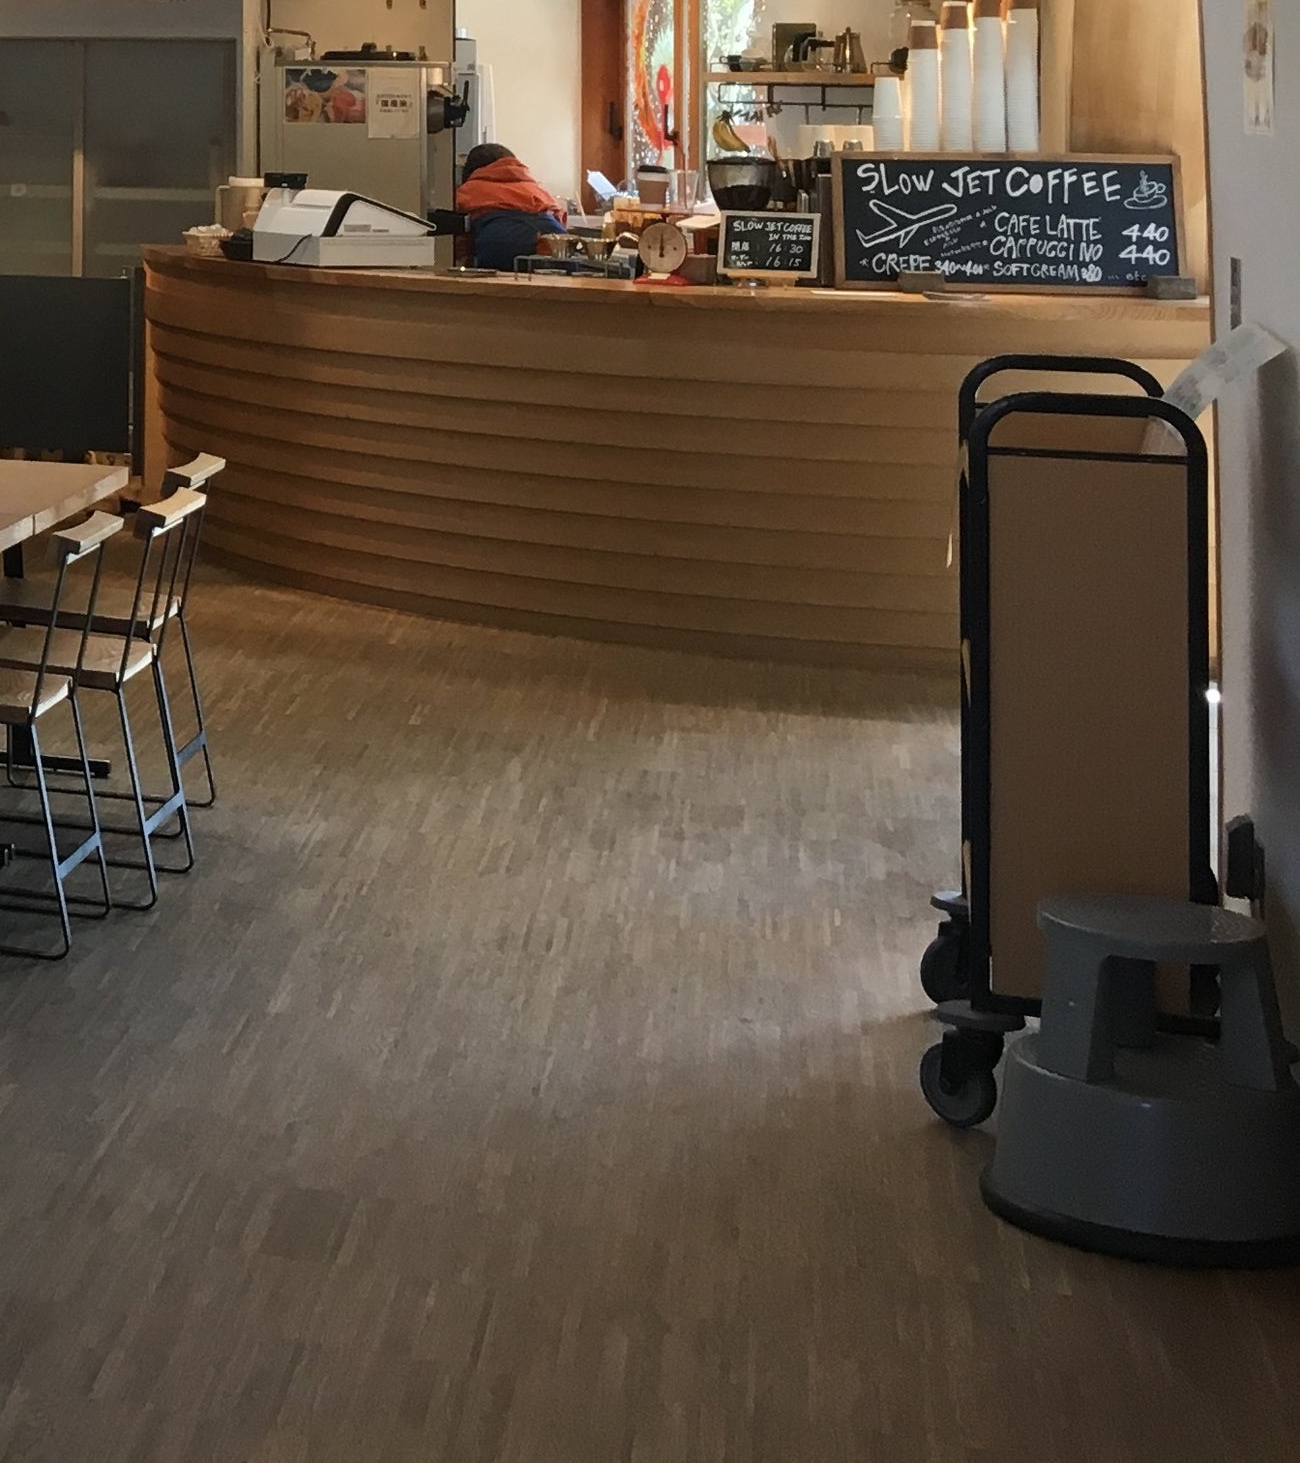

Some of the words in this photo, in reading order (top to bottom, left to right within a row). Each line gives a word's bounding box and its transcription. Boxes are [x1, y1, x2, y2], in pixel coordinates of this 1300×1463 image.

[856, 162, 935, 196] SLOW
[941, 166, 1001, 198] JET
[1005, 166, 1122, 204] COFFEE
[733, 220, 764, 232] SLOW
[764, 221, 784, 232] JET
[783, 222, 813, 233] COFFEE
[994, 211, 1042, 236] CAFE
[1045, 213, 1102, 241] LATTE
[1121, 222, 1170, 242] 440
[1118, 244, 1171, 265] 440
